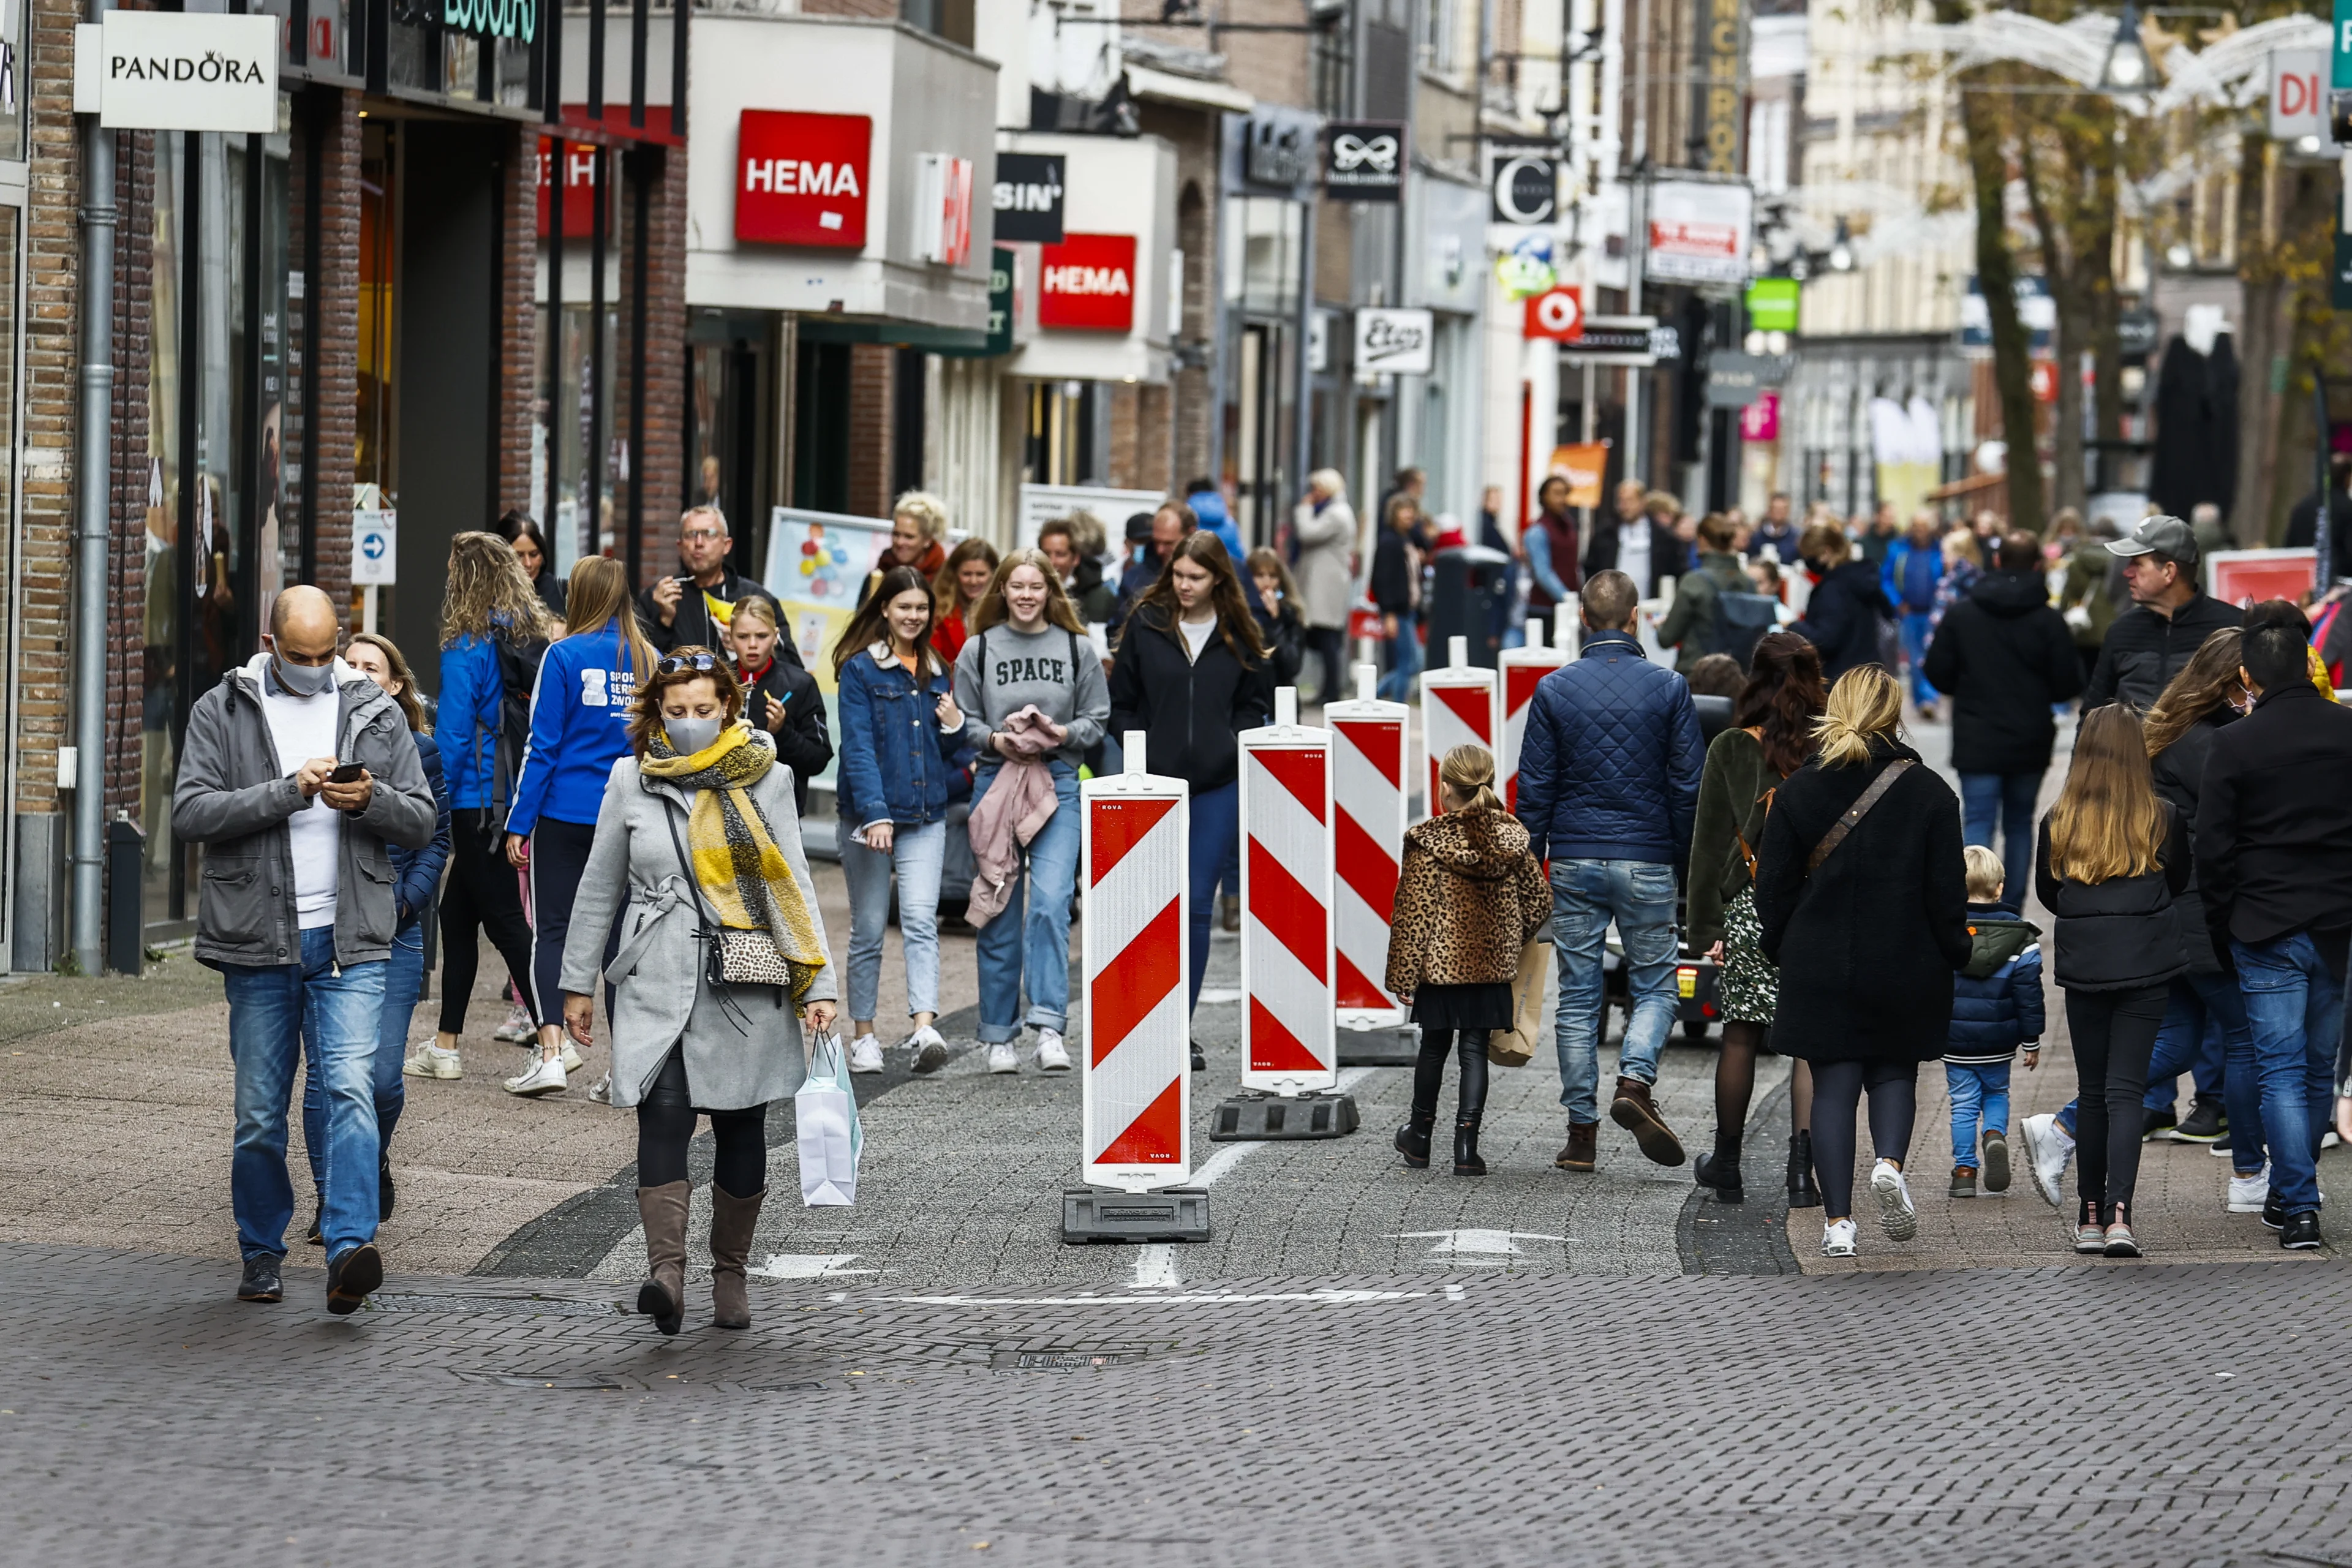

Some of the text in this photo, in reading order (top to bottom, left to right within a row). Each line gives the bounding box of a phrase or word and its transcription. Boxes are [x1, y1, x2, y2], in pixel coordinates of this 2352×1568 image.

[110, 55, 265, 84] PANDORA
[745, 157, 860, 198] HEMA
[1044, 265, 1130, 296] HEMA
[996, 657, 1065, 686] SPACE
